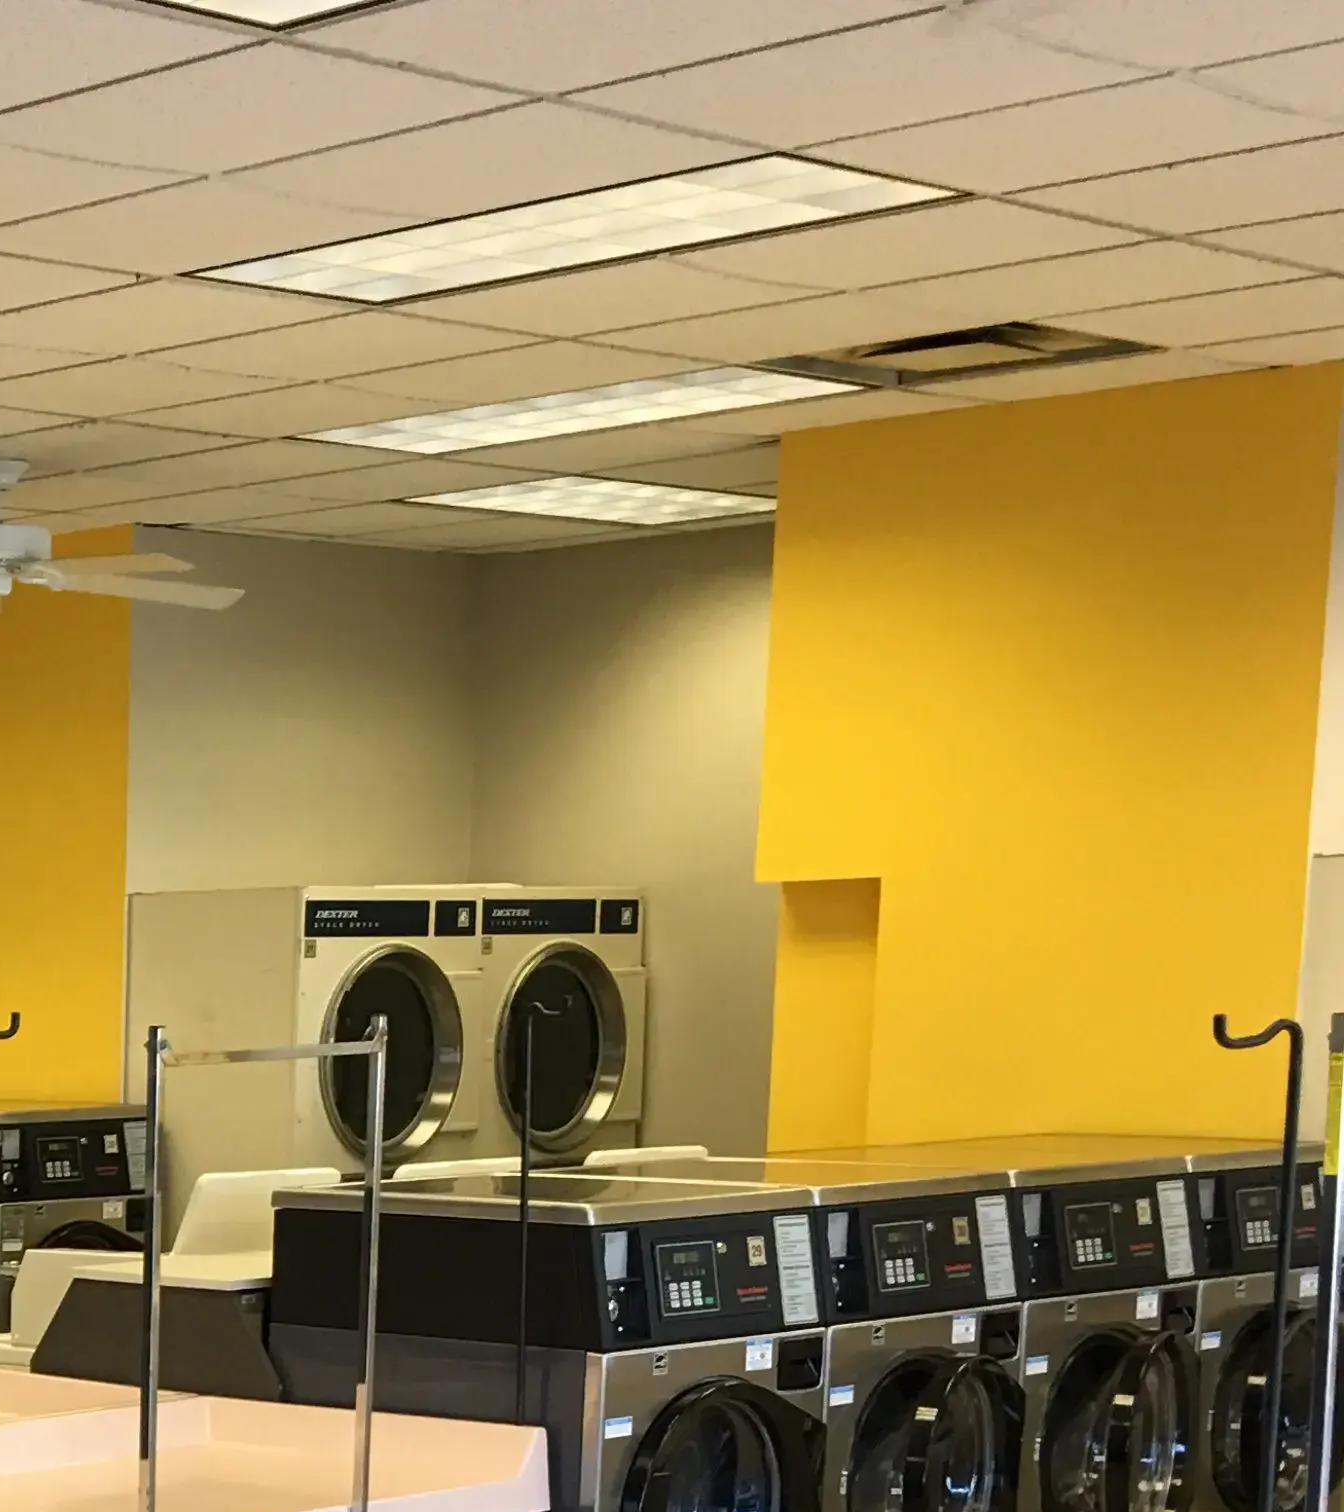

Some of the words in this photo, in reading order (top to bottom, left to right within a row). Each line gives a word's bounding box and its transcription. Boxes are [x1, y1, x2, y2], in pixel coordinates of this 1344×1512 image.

[315, 910, 359, 918] DEXTER
[492, 908, 530, 917] DEXTER
[751, 1244, 763, 1258] 29
